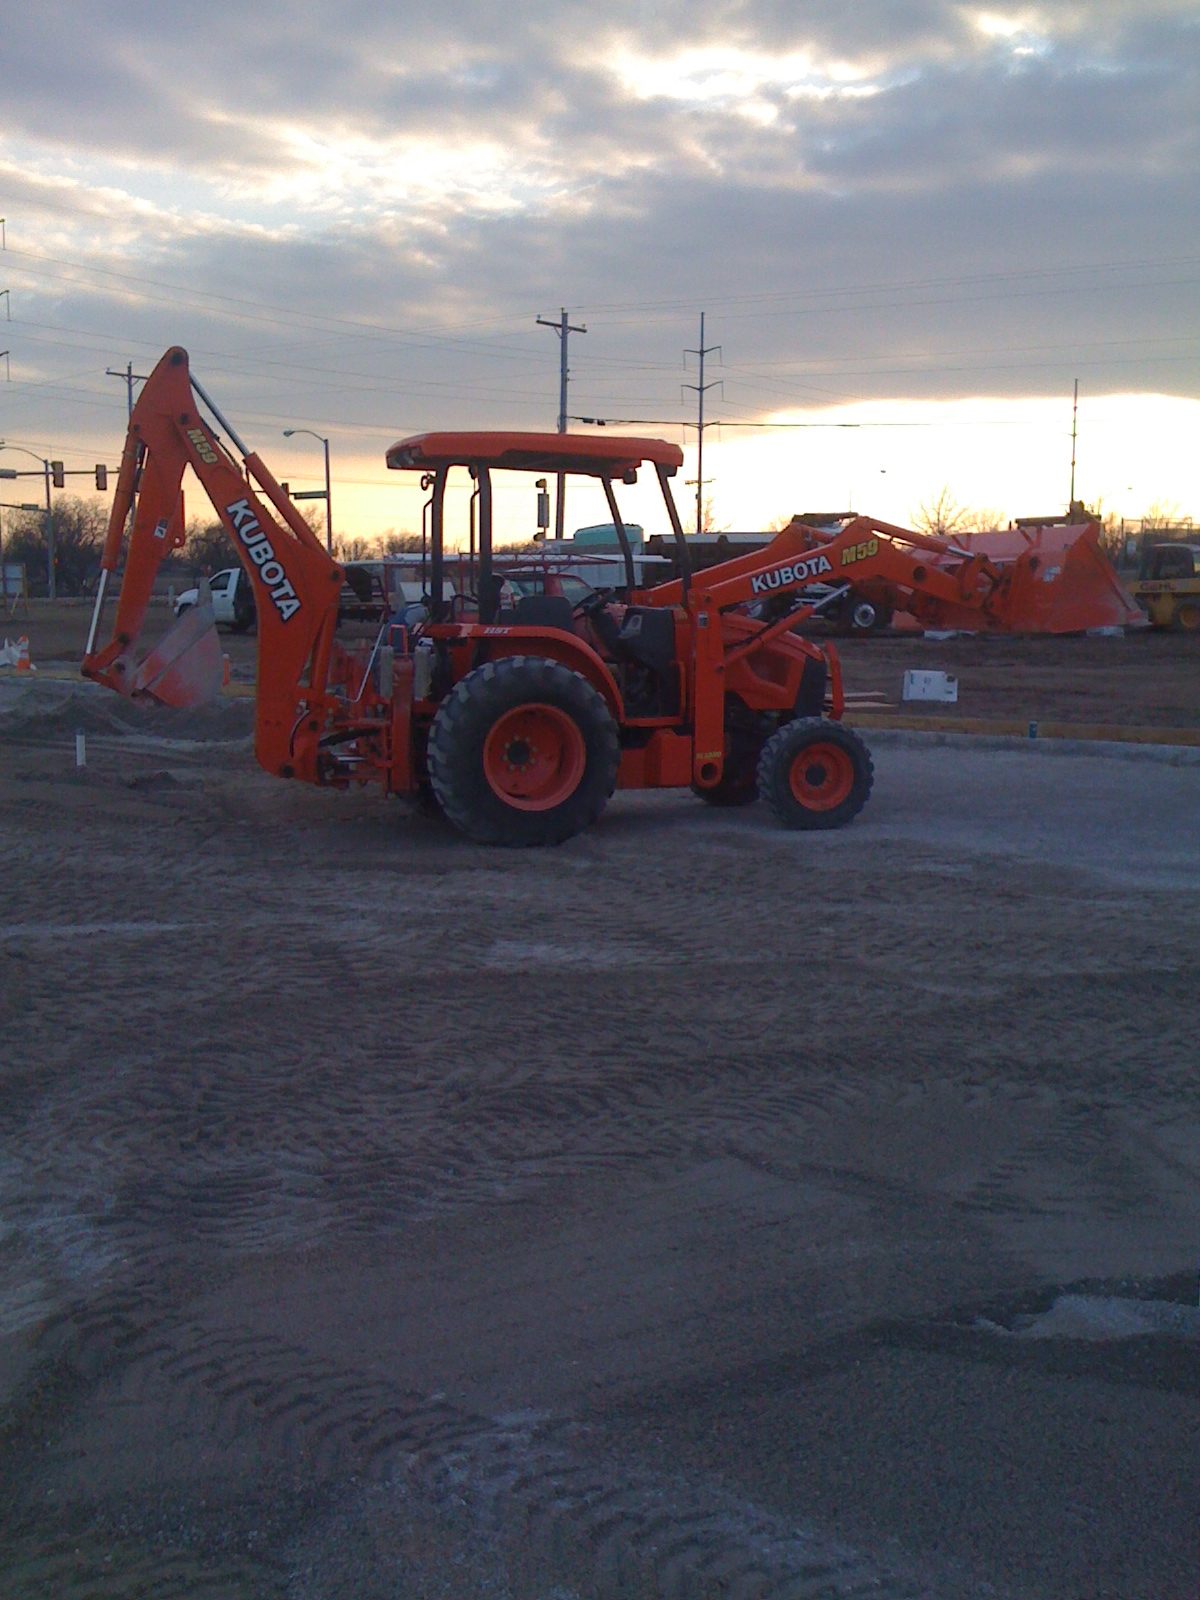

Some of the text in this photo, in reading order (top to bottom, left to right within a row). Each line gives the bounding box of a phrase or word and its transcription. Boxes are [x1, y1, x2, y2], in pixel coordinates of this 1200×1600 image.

[187, 428, 218, 464] M59
[226, 499, 301, 621] KUBOTA
[841, 539, 879, 565] M59
[751, 555, 832, 593] KUBOTA
